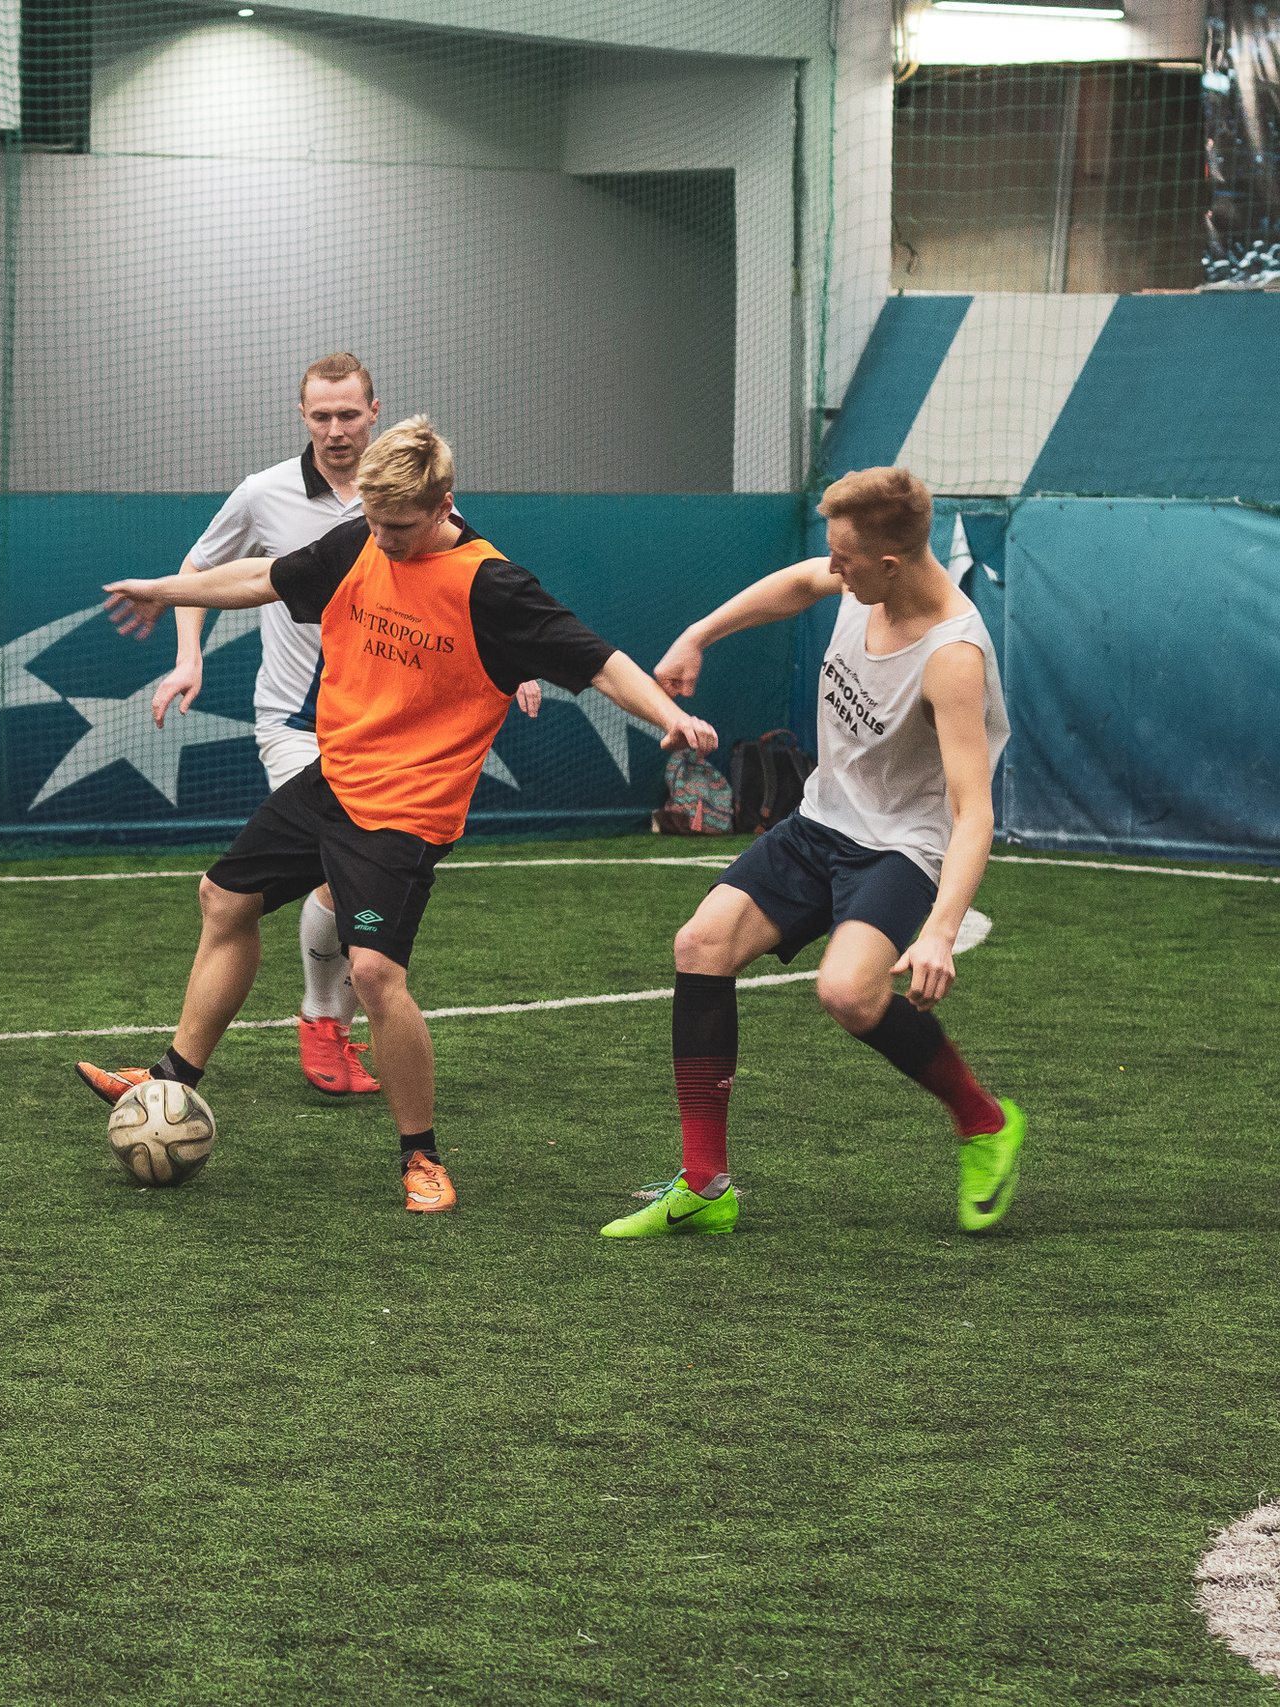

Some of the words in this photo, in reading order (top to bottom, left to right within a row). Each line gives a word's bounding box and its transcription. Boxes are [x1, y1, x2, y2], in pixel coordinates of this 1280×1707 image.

[363, 638, 423, 670] ARENA
[824, 690, 858, 737] ARENA
[353, 924, 378, 932] umbro
